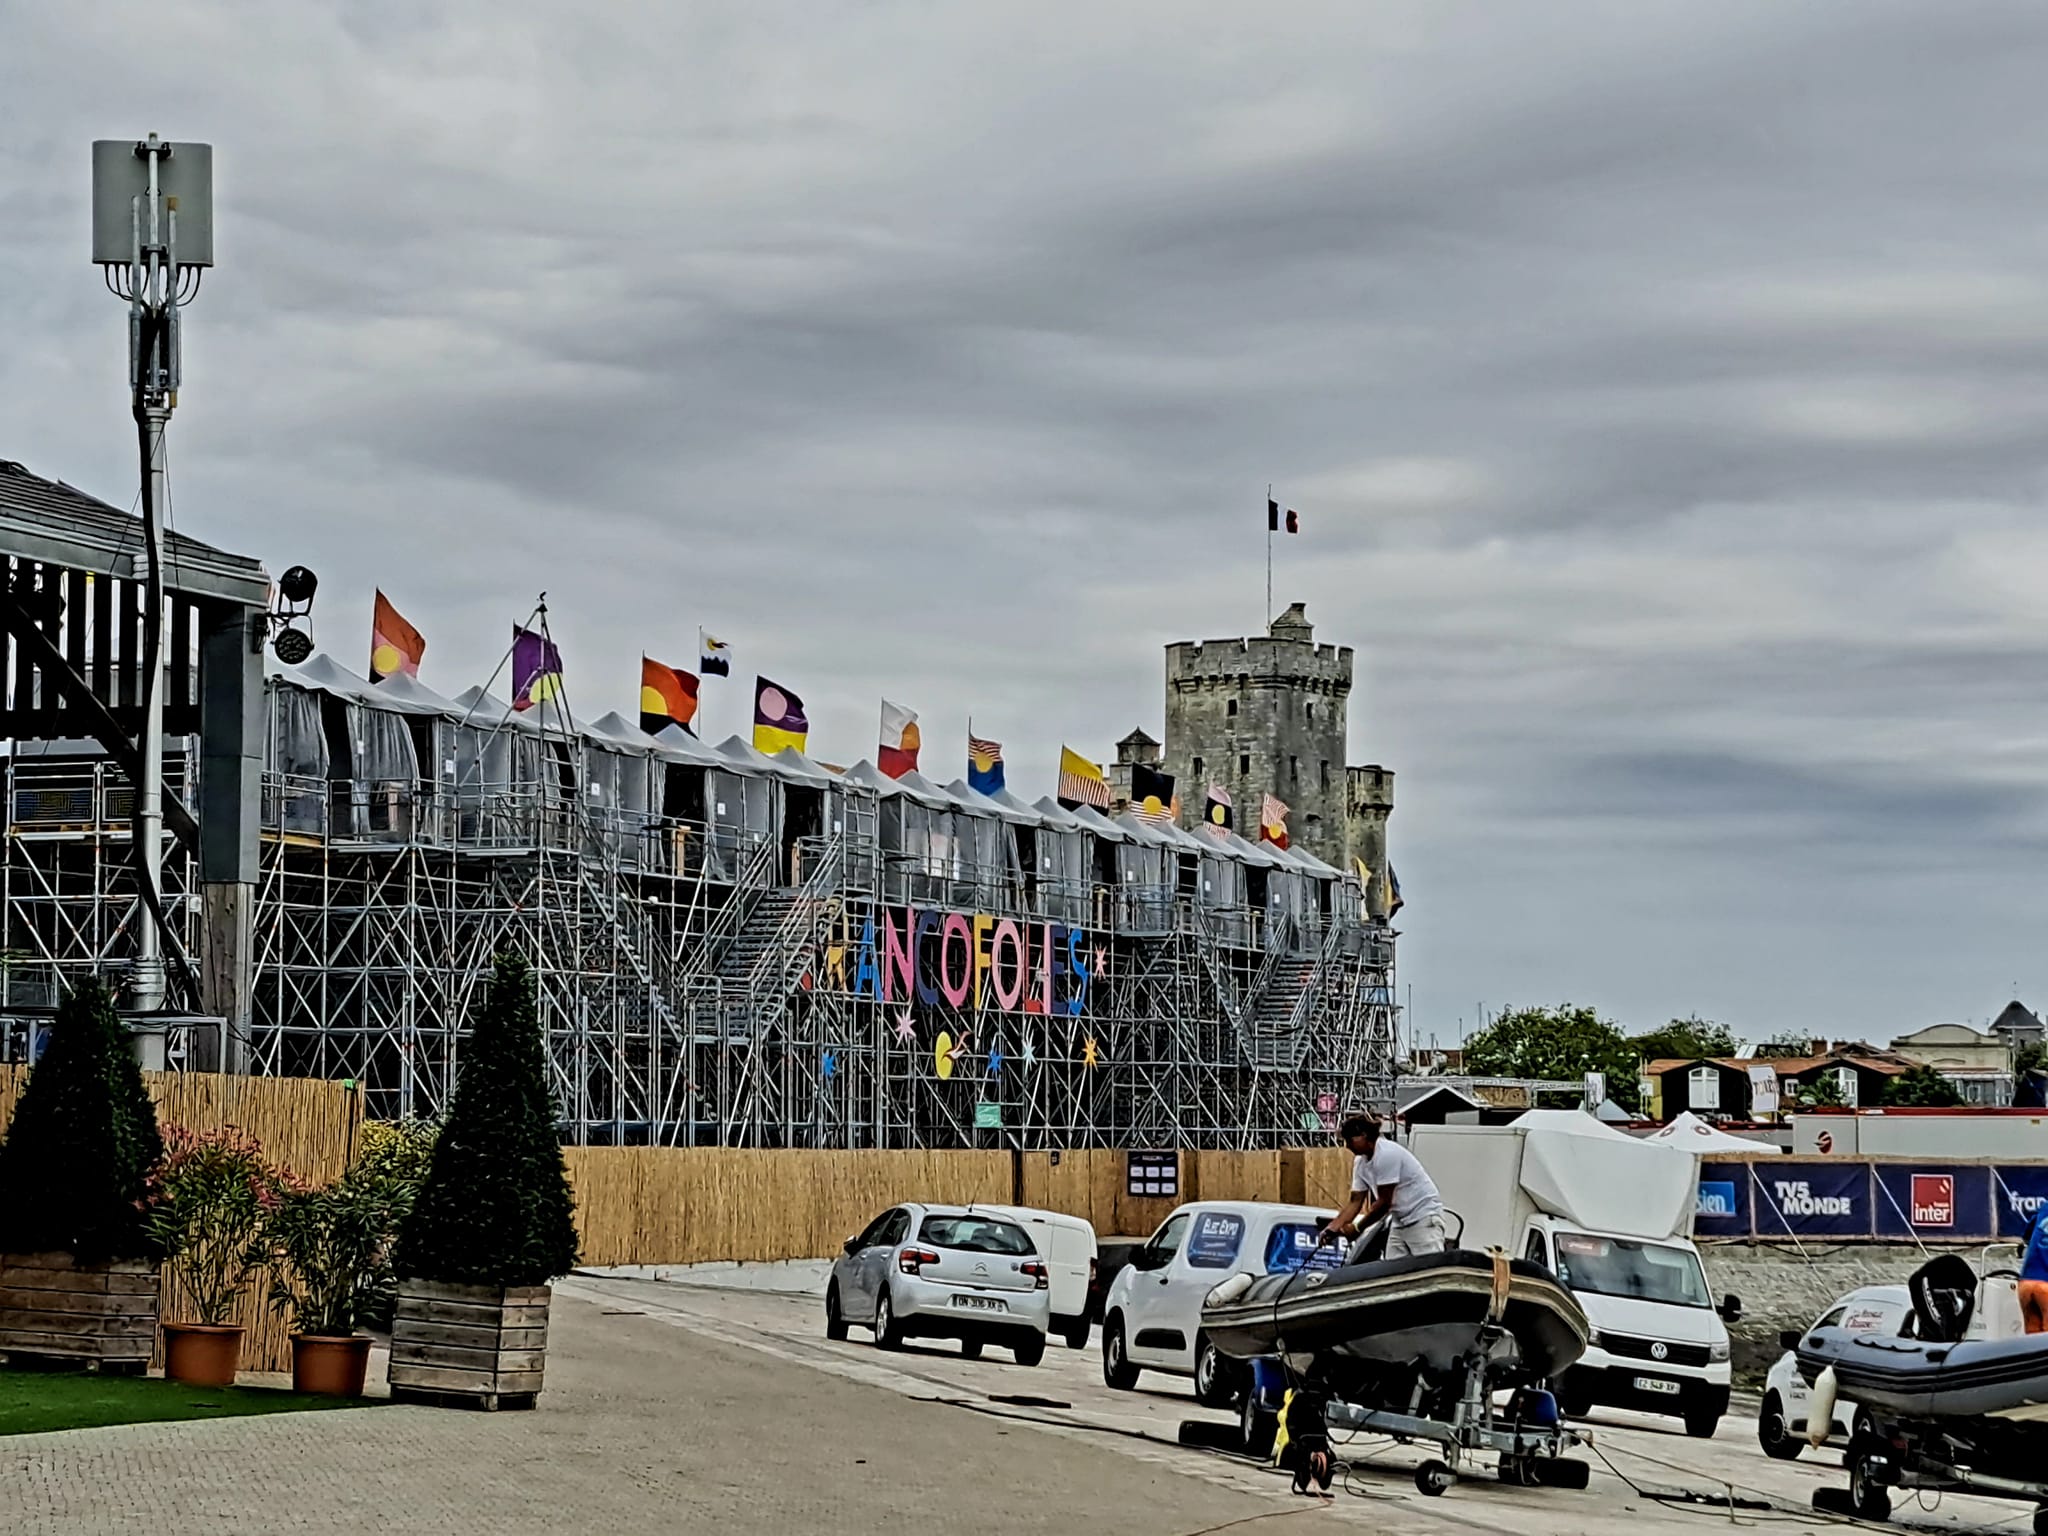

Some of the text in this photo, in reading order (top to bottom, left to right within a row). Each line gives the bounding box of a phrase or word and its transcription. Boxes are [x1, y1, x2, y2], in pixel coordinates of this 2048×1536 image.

[827, 902, 1088, 1016] RANCOFOLIES
[1774, 1181, 1810, 1199] TV5
[1783, 1196, 1851, 1215] MONDE
[2010, 1191, 2047, 1211] fran
[1914, 1202, 1950, 1222] inter
